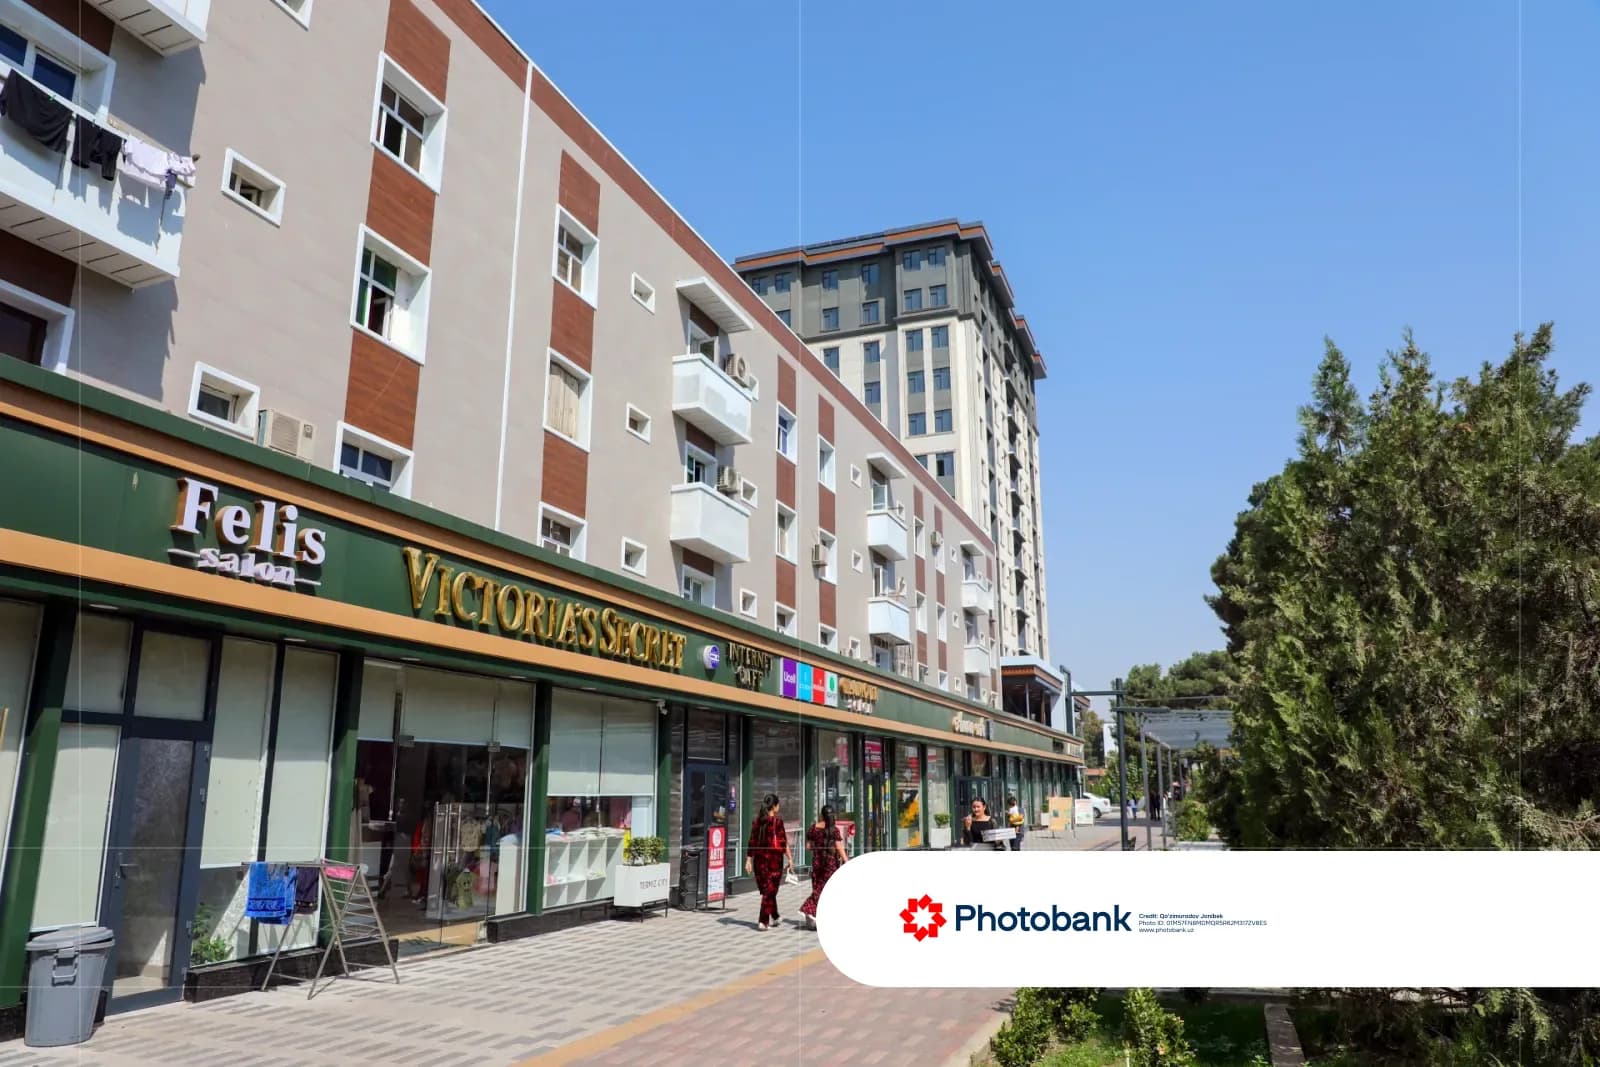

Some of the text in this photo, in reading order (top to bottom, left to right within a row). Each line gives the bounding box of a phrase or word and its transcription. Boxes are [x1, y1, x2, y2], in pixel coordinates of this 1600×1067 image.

[169, 476, 326, 566] Felis
[197, 547, 297, 587] salon
[728, 641, 774, 672] INTERNET
[783, 671, 796, 684] Ucell
